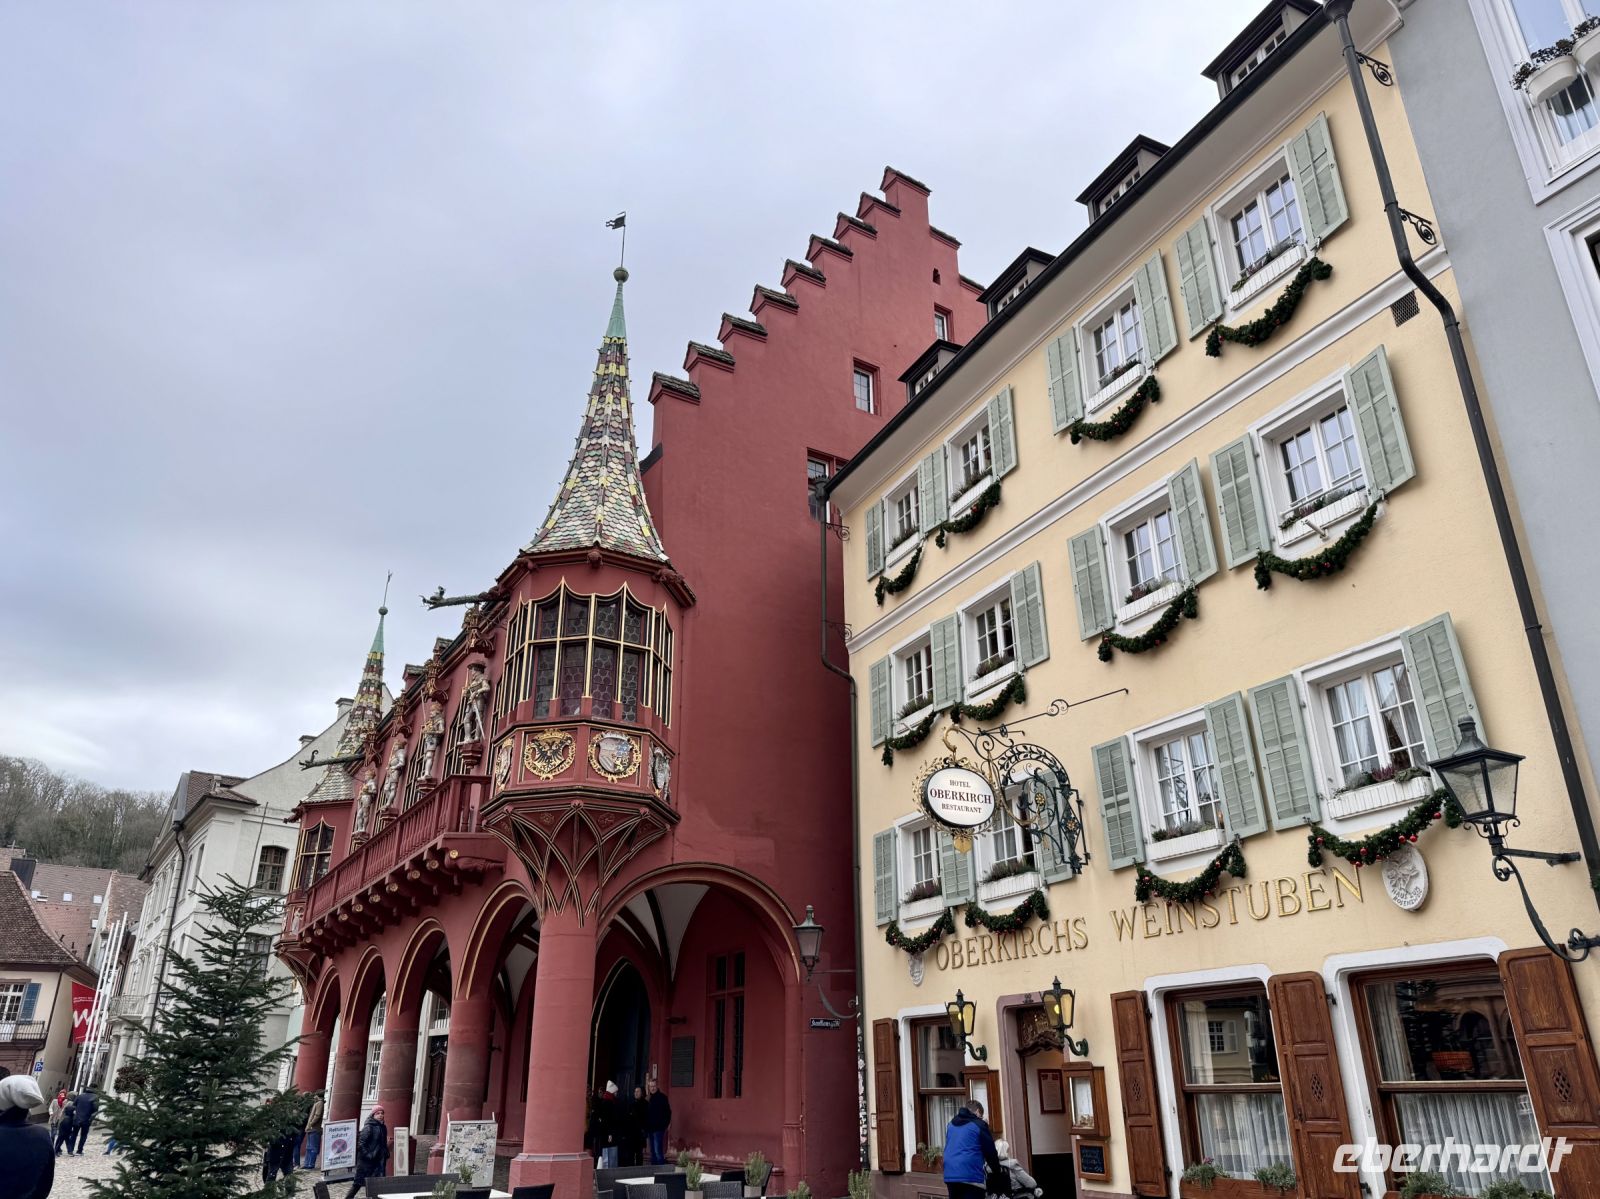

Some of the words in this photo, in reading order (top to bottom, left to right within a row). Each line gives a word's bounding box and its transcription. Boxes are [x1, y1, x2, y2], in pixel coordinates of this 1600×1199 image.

[949, 779, 971, 788] HOTEL
[930, 788, 992, 804] OBERKIRCH
[941, 803, 982, 813] RESTAURANT
[936, 917, 1089, 971] OBERKIRCHS
[1109, 865, 1364, 942] WEINSTUBEN
